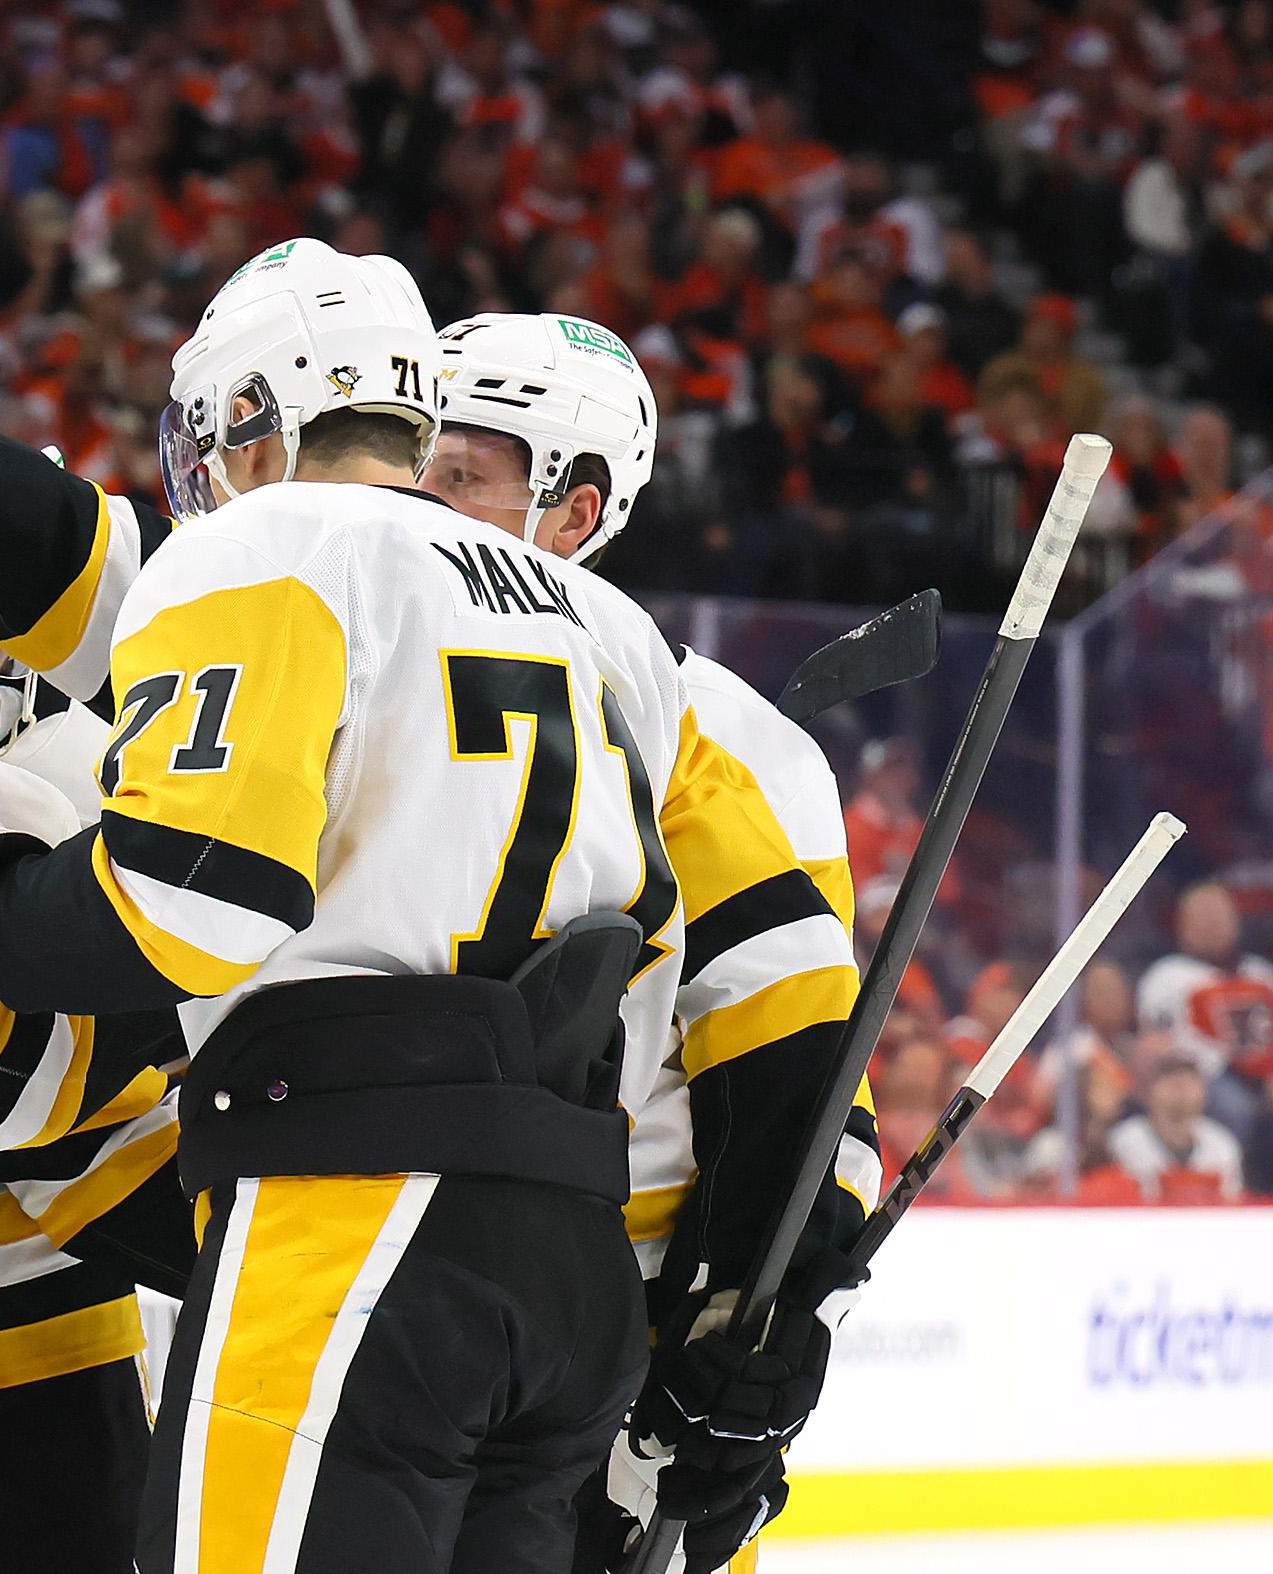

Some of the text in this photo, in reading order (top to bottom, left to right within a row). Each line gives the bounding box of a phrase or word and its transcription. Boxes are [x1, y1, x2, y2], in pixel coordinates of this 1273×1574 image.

[391, 354, 424, 403] 71
[562, 321, 631, 361] MSA
[429, 541, 587, 632] MALK
[98, 663, 245, 799] 71
[439, 648, 678, 979] 71
